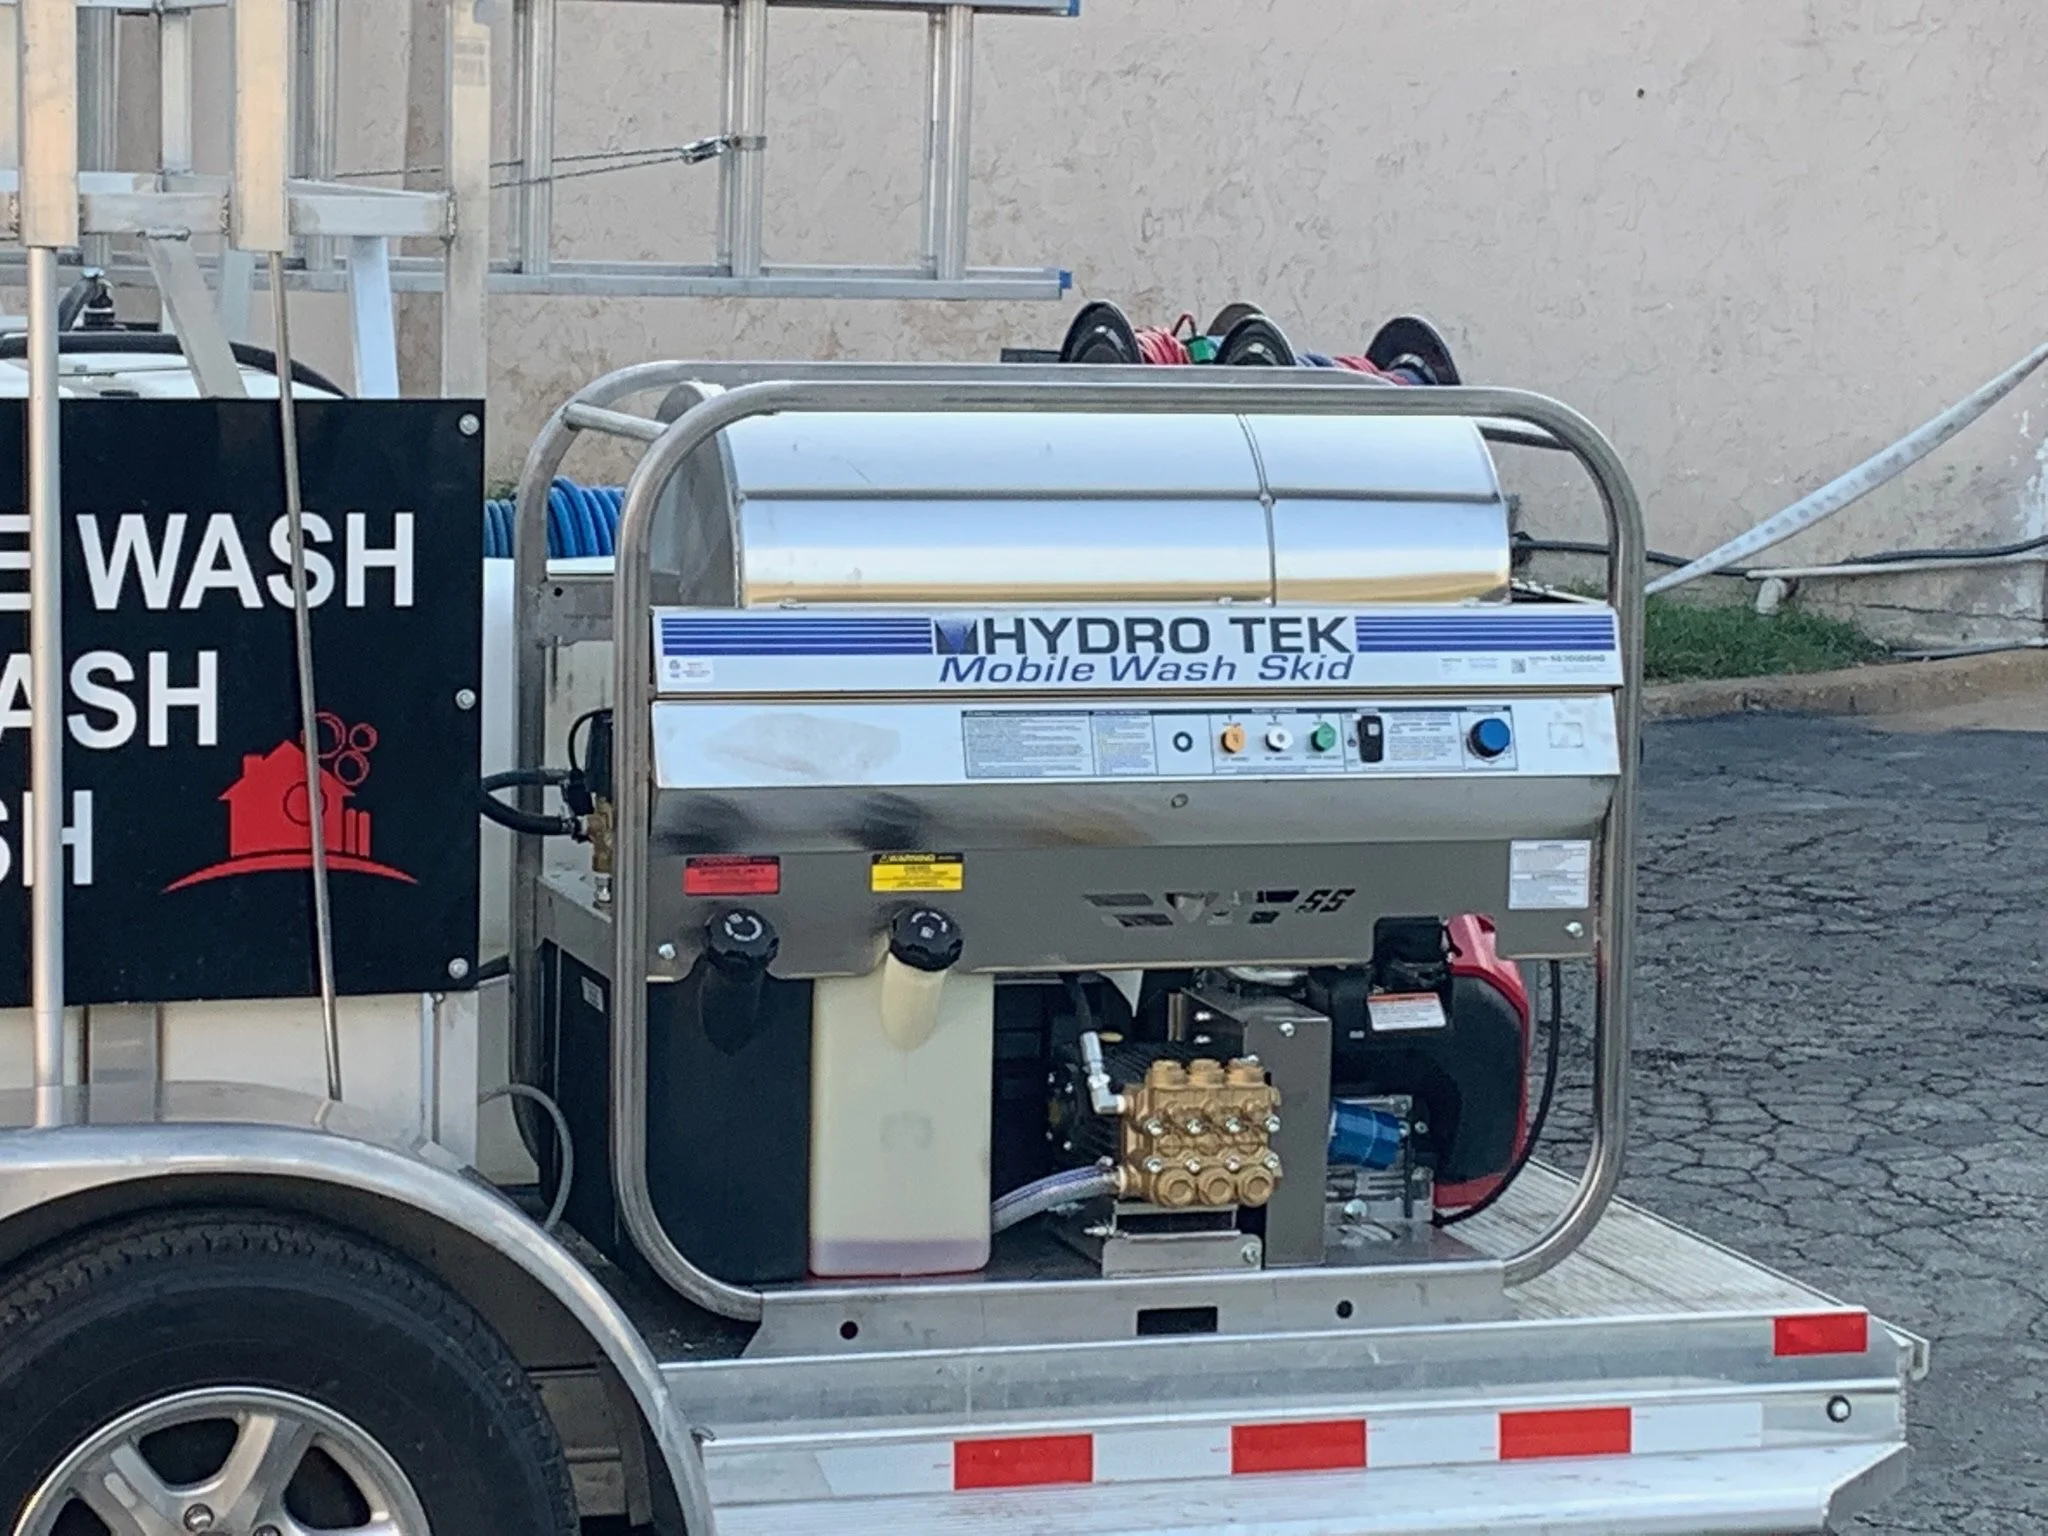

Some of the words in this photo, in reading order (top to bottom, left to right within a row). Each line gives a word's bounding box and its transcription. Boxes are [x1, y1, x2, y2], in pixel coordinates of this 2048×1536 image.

[76, 512, 414, 610] WASH
[983, 616, 1210, 655] HYDRO
[1229, 616, 1352, 654] TEK
[939, 656, 1096, 683] Mobile
[1110, 655, 1238, 682] Wash
[1257, 654, 1355, 681] Skid
